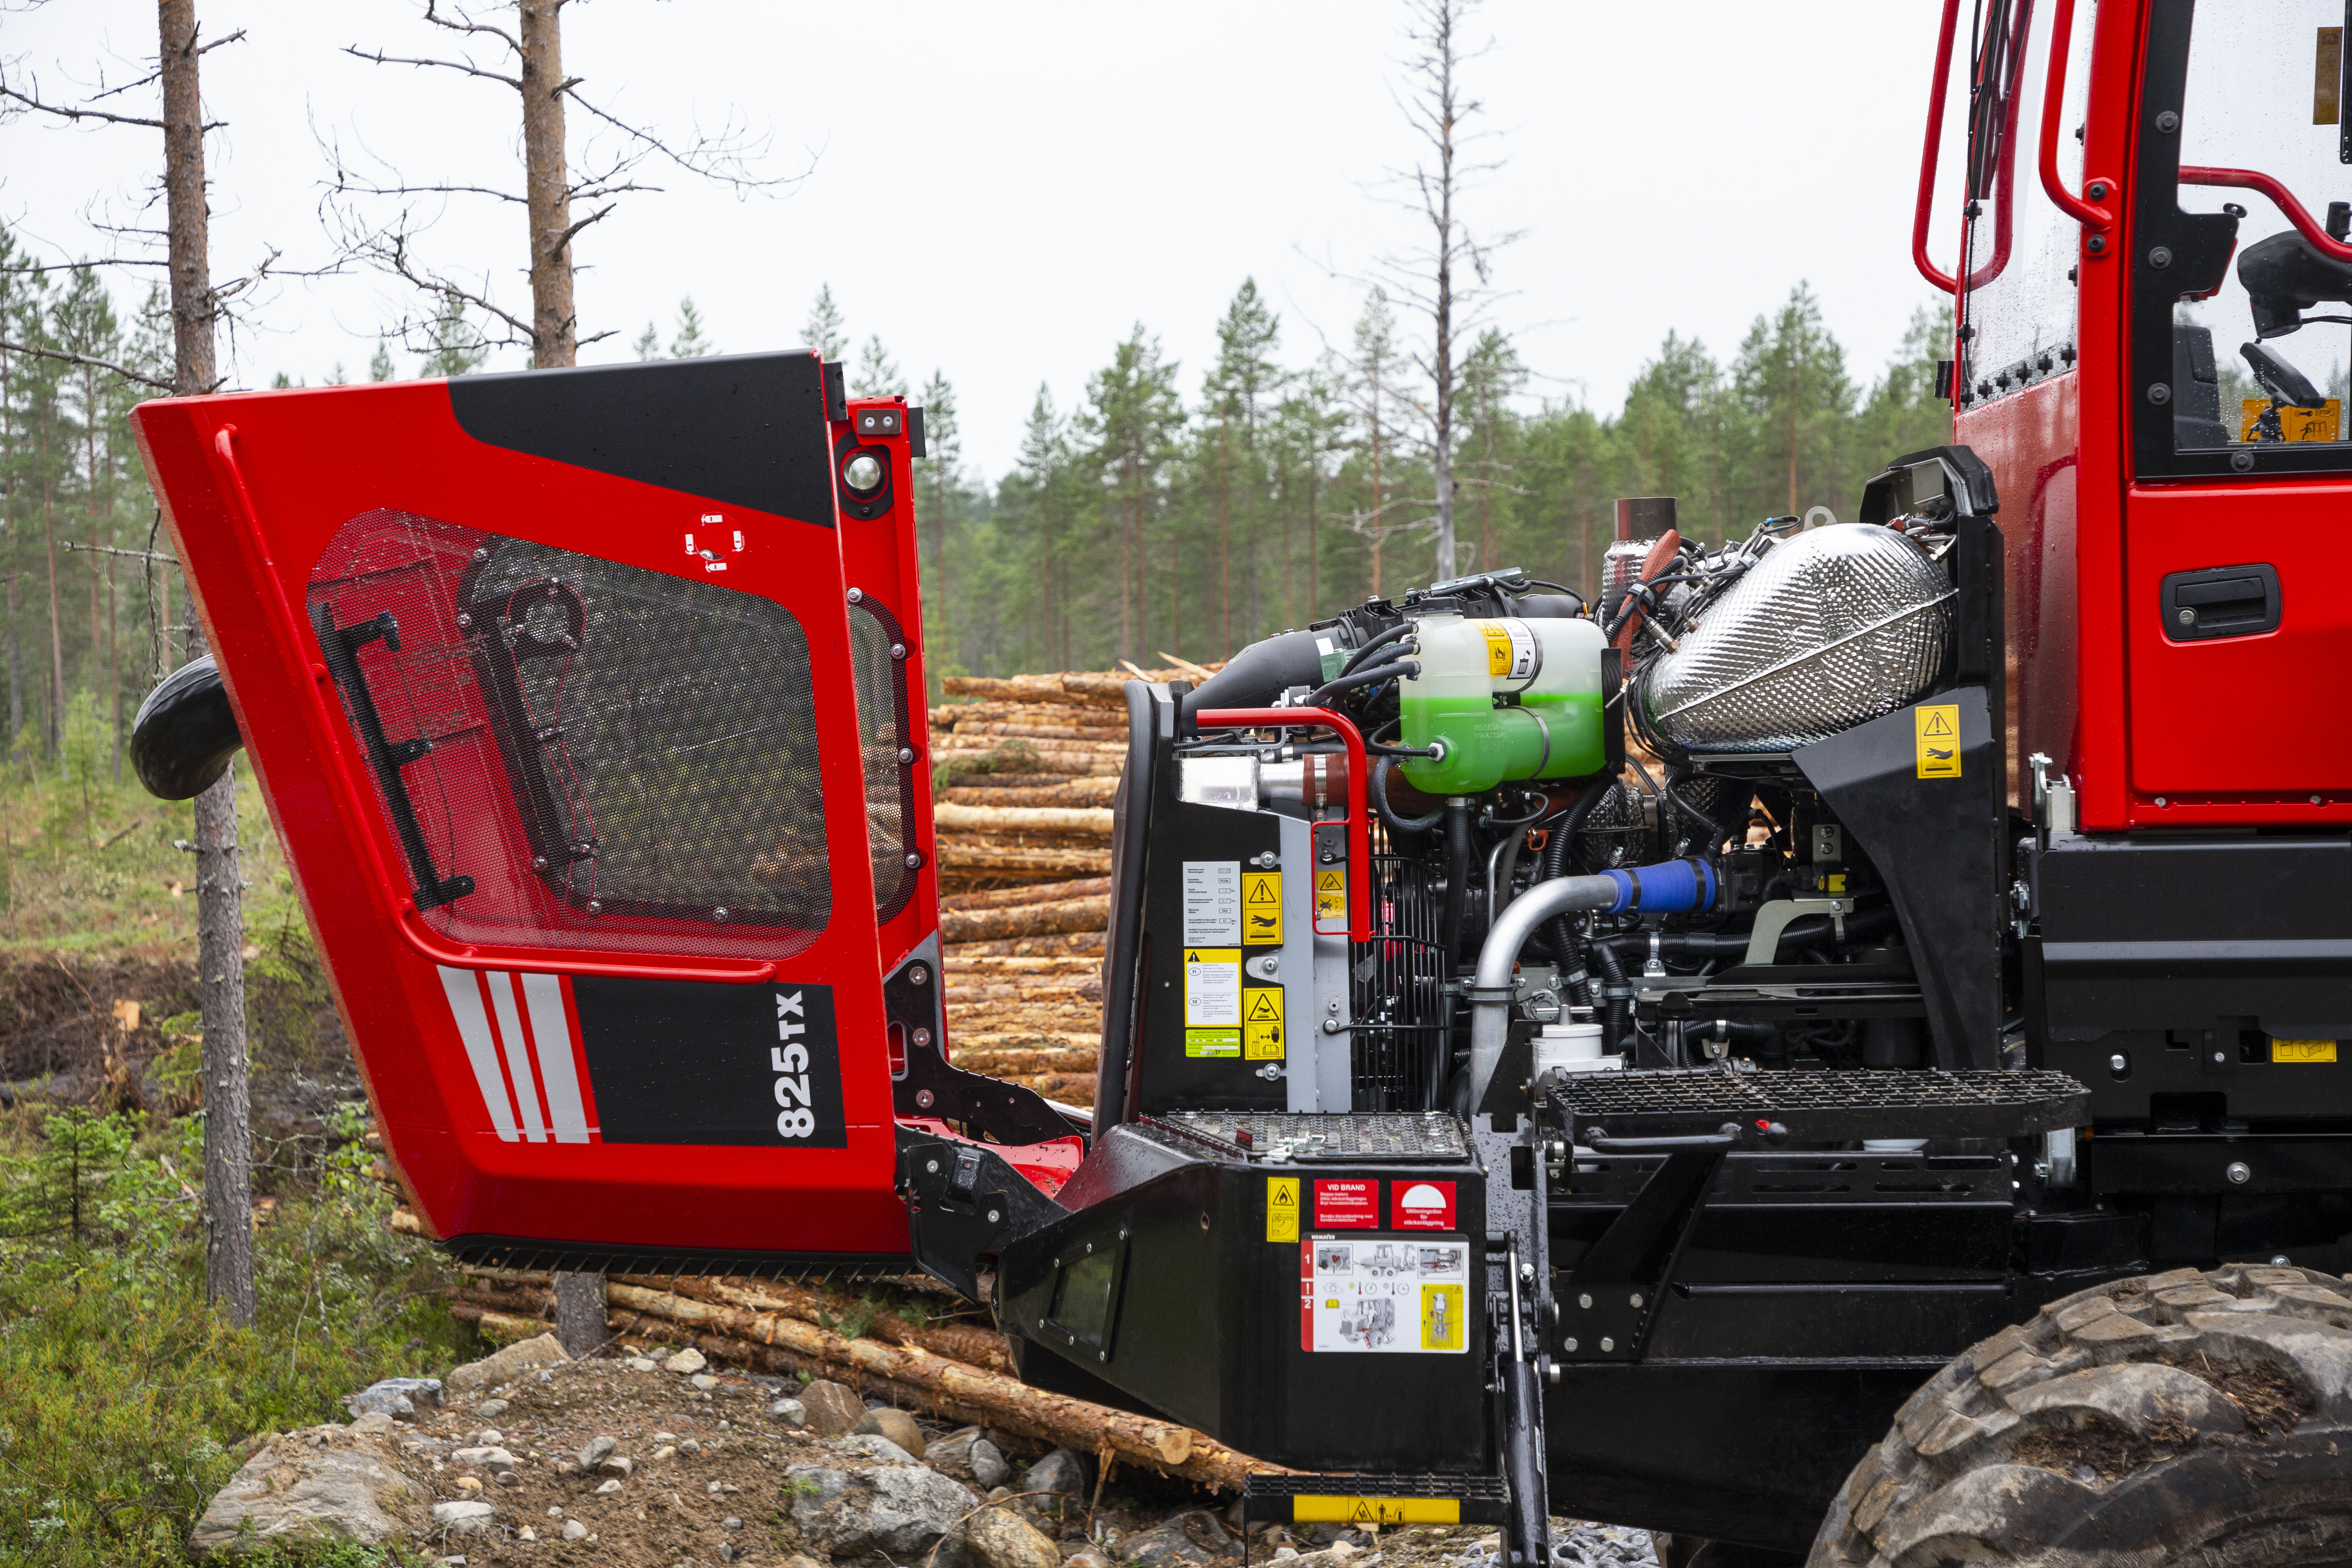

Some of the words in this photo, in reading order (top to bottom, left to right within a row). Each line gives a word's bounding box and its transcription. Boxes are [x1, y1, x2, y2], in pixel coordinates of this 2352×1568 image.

[771, 990, 815, 1138] 825TX
[1305, 1254, 1310, 1264] 1
[1304, 1299, 1311, 1308] 2
